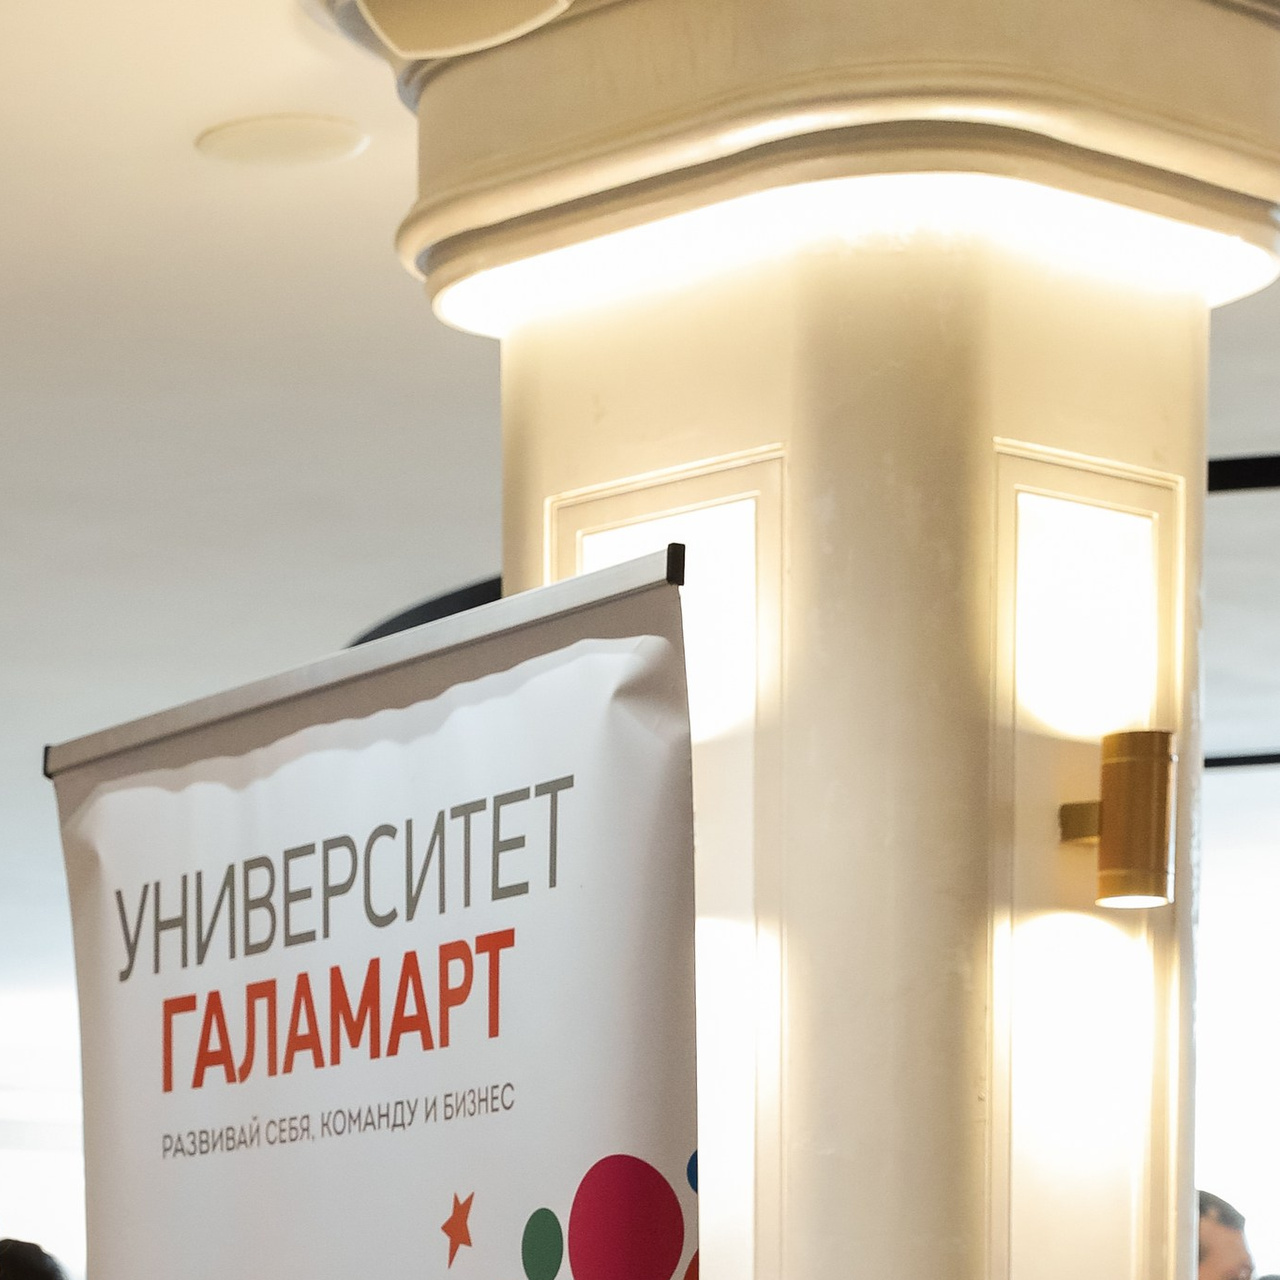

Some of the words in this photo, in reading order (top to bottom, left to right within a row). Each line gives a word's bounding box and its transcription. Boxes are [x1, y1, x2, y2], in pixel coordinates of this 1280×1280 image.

[115, 774, 575, 983] УНИВЕРСИТЕТ
[161, 928, 516, 1094] ГАЛАМАРТ
[161, 1116, 261, 1159] РАЗВИВАЙ
[265, 1115, 315, 1146] СЕБЯ,
[321, 1098, 419, 1138] КОМАНДУ
[424, 1096, 438, 1123] И
[444, 1082, 516, 1121] БИЗНЕС
